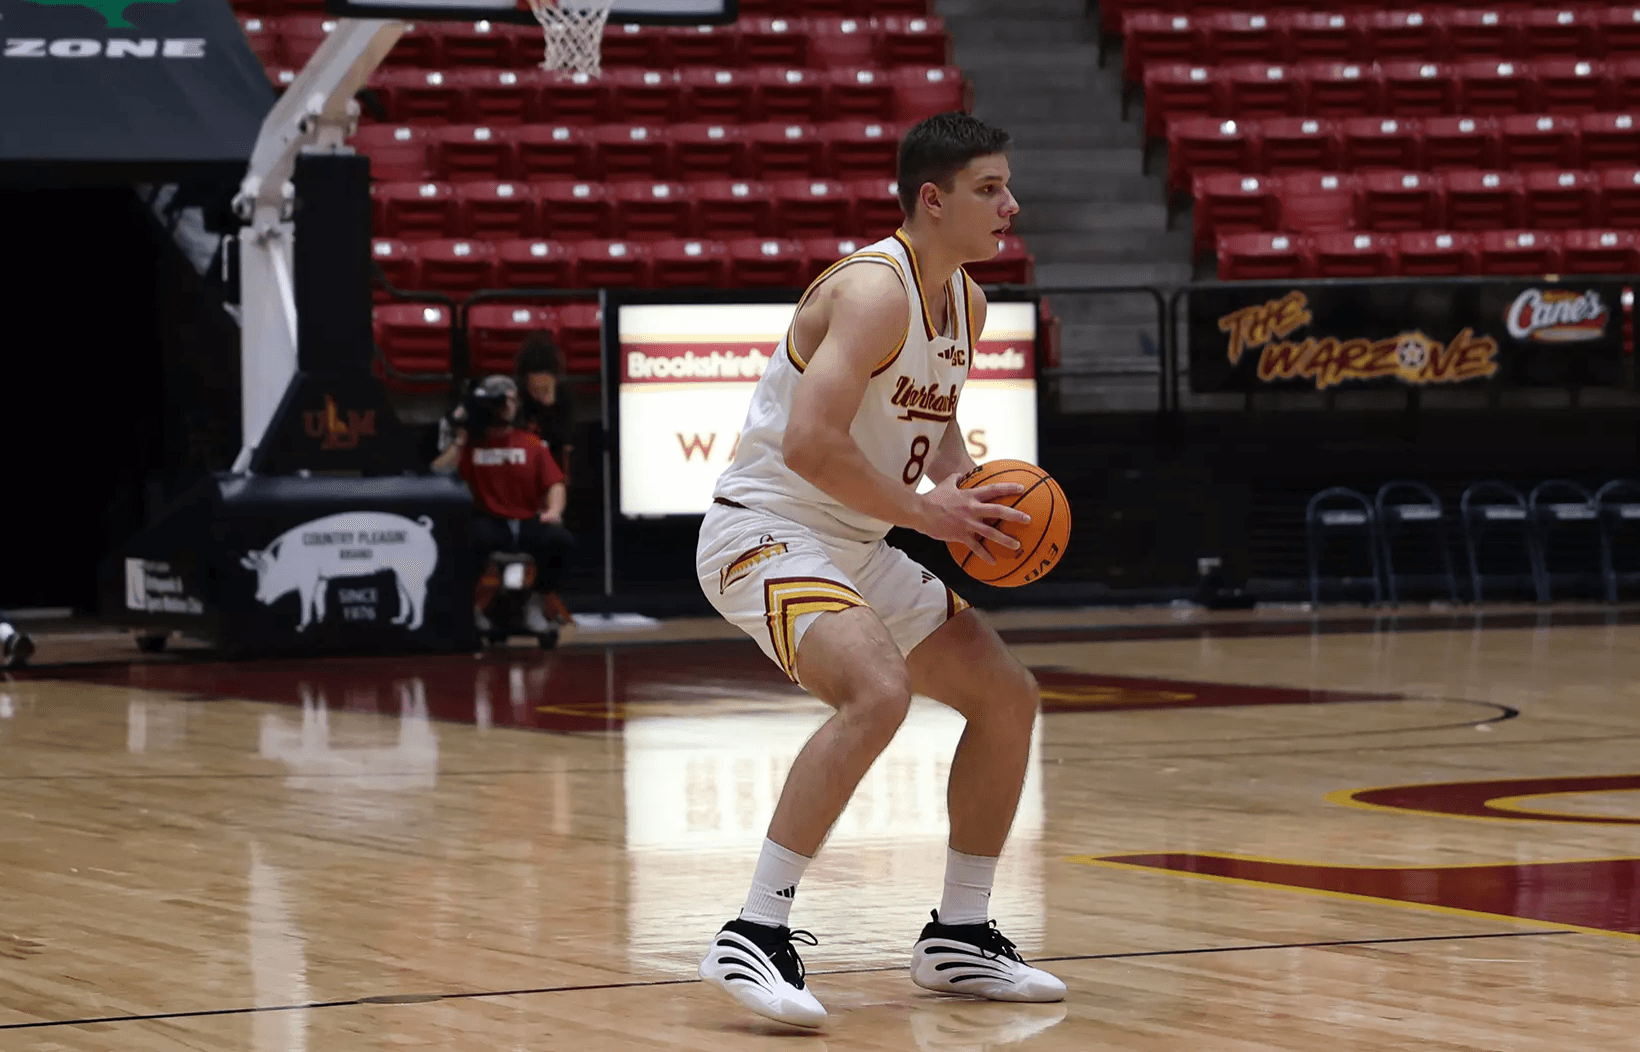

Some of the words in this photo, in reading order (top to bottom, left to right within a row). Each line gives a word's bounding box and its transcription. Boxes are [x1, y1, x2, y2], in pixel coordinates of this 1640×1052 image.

[4, 38, 206, 58] ZONE
[1218, 290, 1312, 365] THE
[1507, 288, 1605, 338] Cane's
[1257, 327, 1499, 390] WARZONE
[891, 375, 958, 413] Warhawk
[473, 447, 527, 466] ESPN
[903, 435, 930, 485] 8
[338, 587, 378, 604] SINCE
